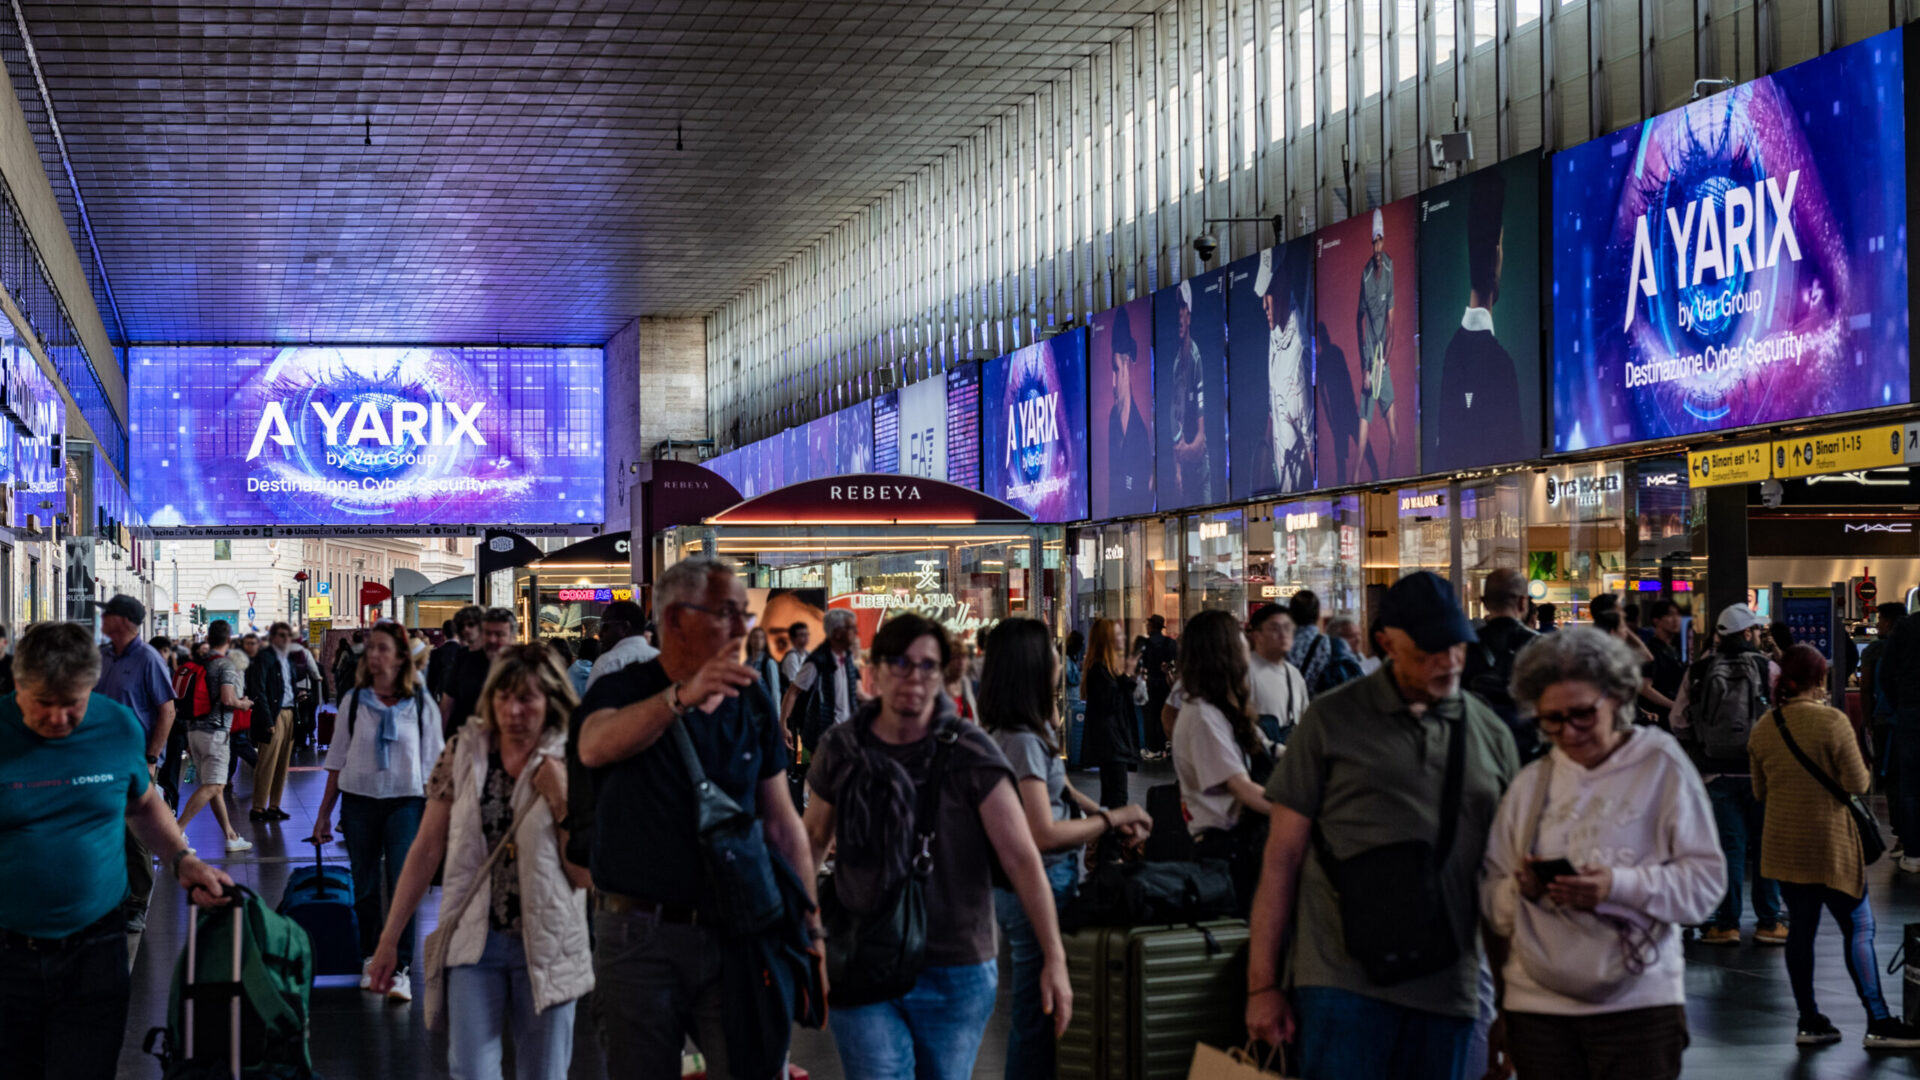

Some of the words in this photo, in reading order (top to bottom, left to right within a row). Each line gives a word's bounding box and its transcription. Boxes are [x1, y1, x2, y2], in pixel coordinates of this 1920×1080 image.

[1666, 169, 1803, 290] YARIX
[1678, 301, 1694, 332] by
[1695, 297, 1719, 322] Var
[1721, 289, 1763, 318] Group
[1625, 353, 1703, 388] Destinazione
[1704, 344, 1744, 374] Cyber
[1746, 331, 1804, 366] Security
[311, 401, 488, 446] YARIX
[1018, 391, 1059, 448] YARIX
[1816, 439, 1839, 456] Binari
[1842, 435, 1862, 452] 1-15
[326, 453, 347, 468] by
[351, 452, 381, 465] Var
[386, 451, 438, 468] Group
[1712, 452, 1733, 468] Binari
[1735, 453, 1744, 465] est
[1747, 448, 1760, 464] 1-2
[247, 478, 359, 493] Destinazione
[362, 476, 412, 495] Cyber
[418, 478, 486, 494] Security
[663, 480, 710, 489] REBEYA
[1646, 473, 1678, 487] MAC
[830, 485, 922, 500] REBEYA
[1401, 498, 1409, 510] JO
[1410, 493, 1439, 509] MALONE
[189, 528, 201, 536] Via
[205, 528, 240, 536] Marsala
[294, 528, 319, 536] Uscita
[334, 528, 355, 536] Viale
[358, 527, 384, 535] Castro
[386, 526, 420, 536] Pretorio
[443, 526, 460, 535] Taxi
[1845, 523, 1912, 533] MAC
[559, 589, 595, 600] COME
[595, 589, 611, 600] AS
[851, 594, 903, 608] LIBERA
[904, 594, 921, 607] LA
[922, 593, 956, 607] TUA
[72, 774, 114, 786] LONDON
